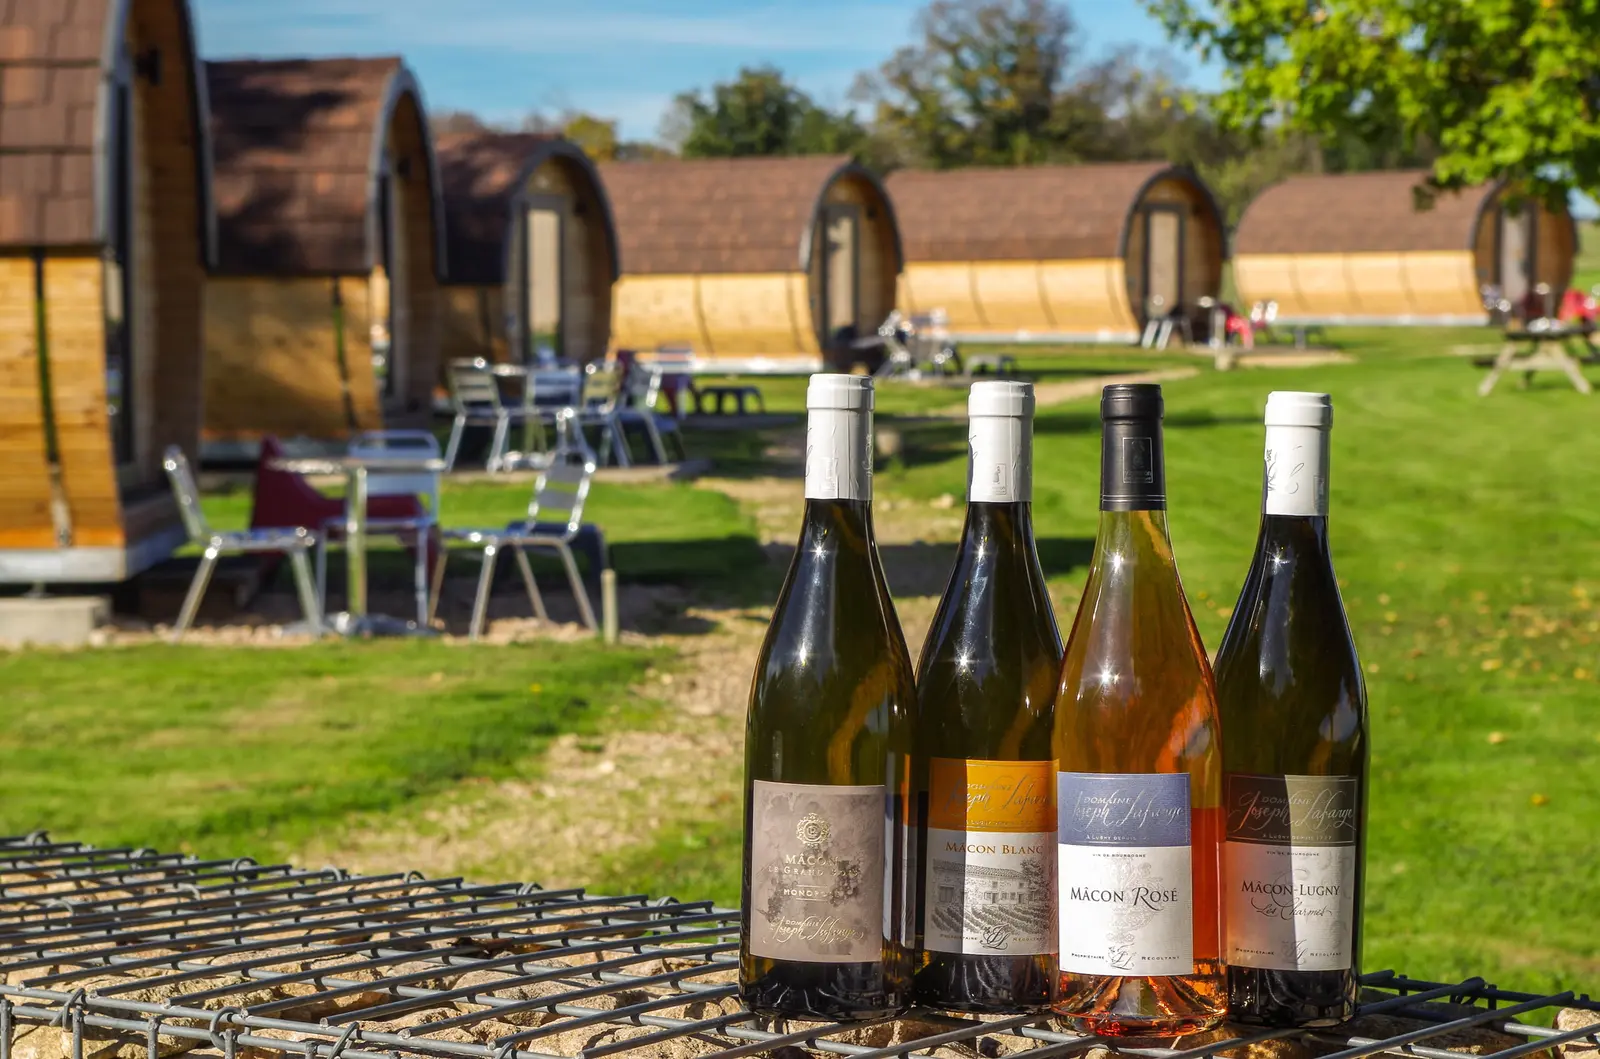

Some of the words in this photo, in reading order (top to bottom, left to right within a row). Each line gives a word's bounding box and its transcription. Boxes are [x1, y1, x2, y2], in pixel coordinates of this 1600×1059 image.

[1084, 796, 1133, 804] DOMAINE
[1261, 796, 1311, 804] DOMAINE
[1229, 789, 1296, 831] Joseph
[1290, 787, 1356, 832] Lafarge
[945, 841, 996, 854] MÂCON
[1002, 844, 1044, 855] BLANC
[785, 853, 838, 867] MÂCON
[783, 866, 824, 876] GRAND
[1241, 879, 1341, 896] MÂCON-LUGNY
[1071, 886, 1124, 903] MÂCON
[1132, 886, 1179, 911] ROSÉ
[1250, 893, 1279, 917] Les
